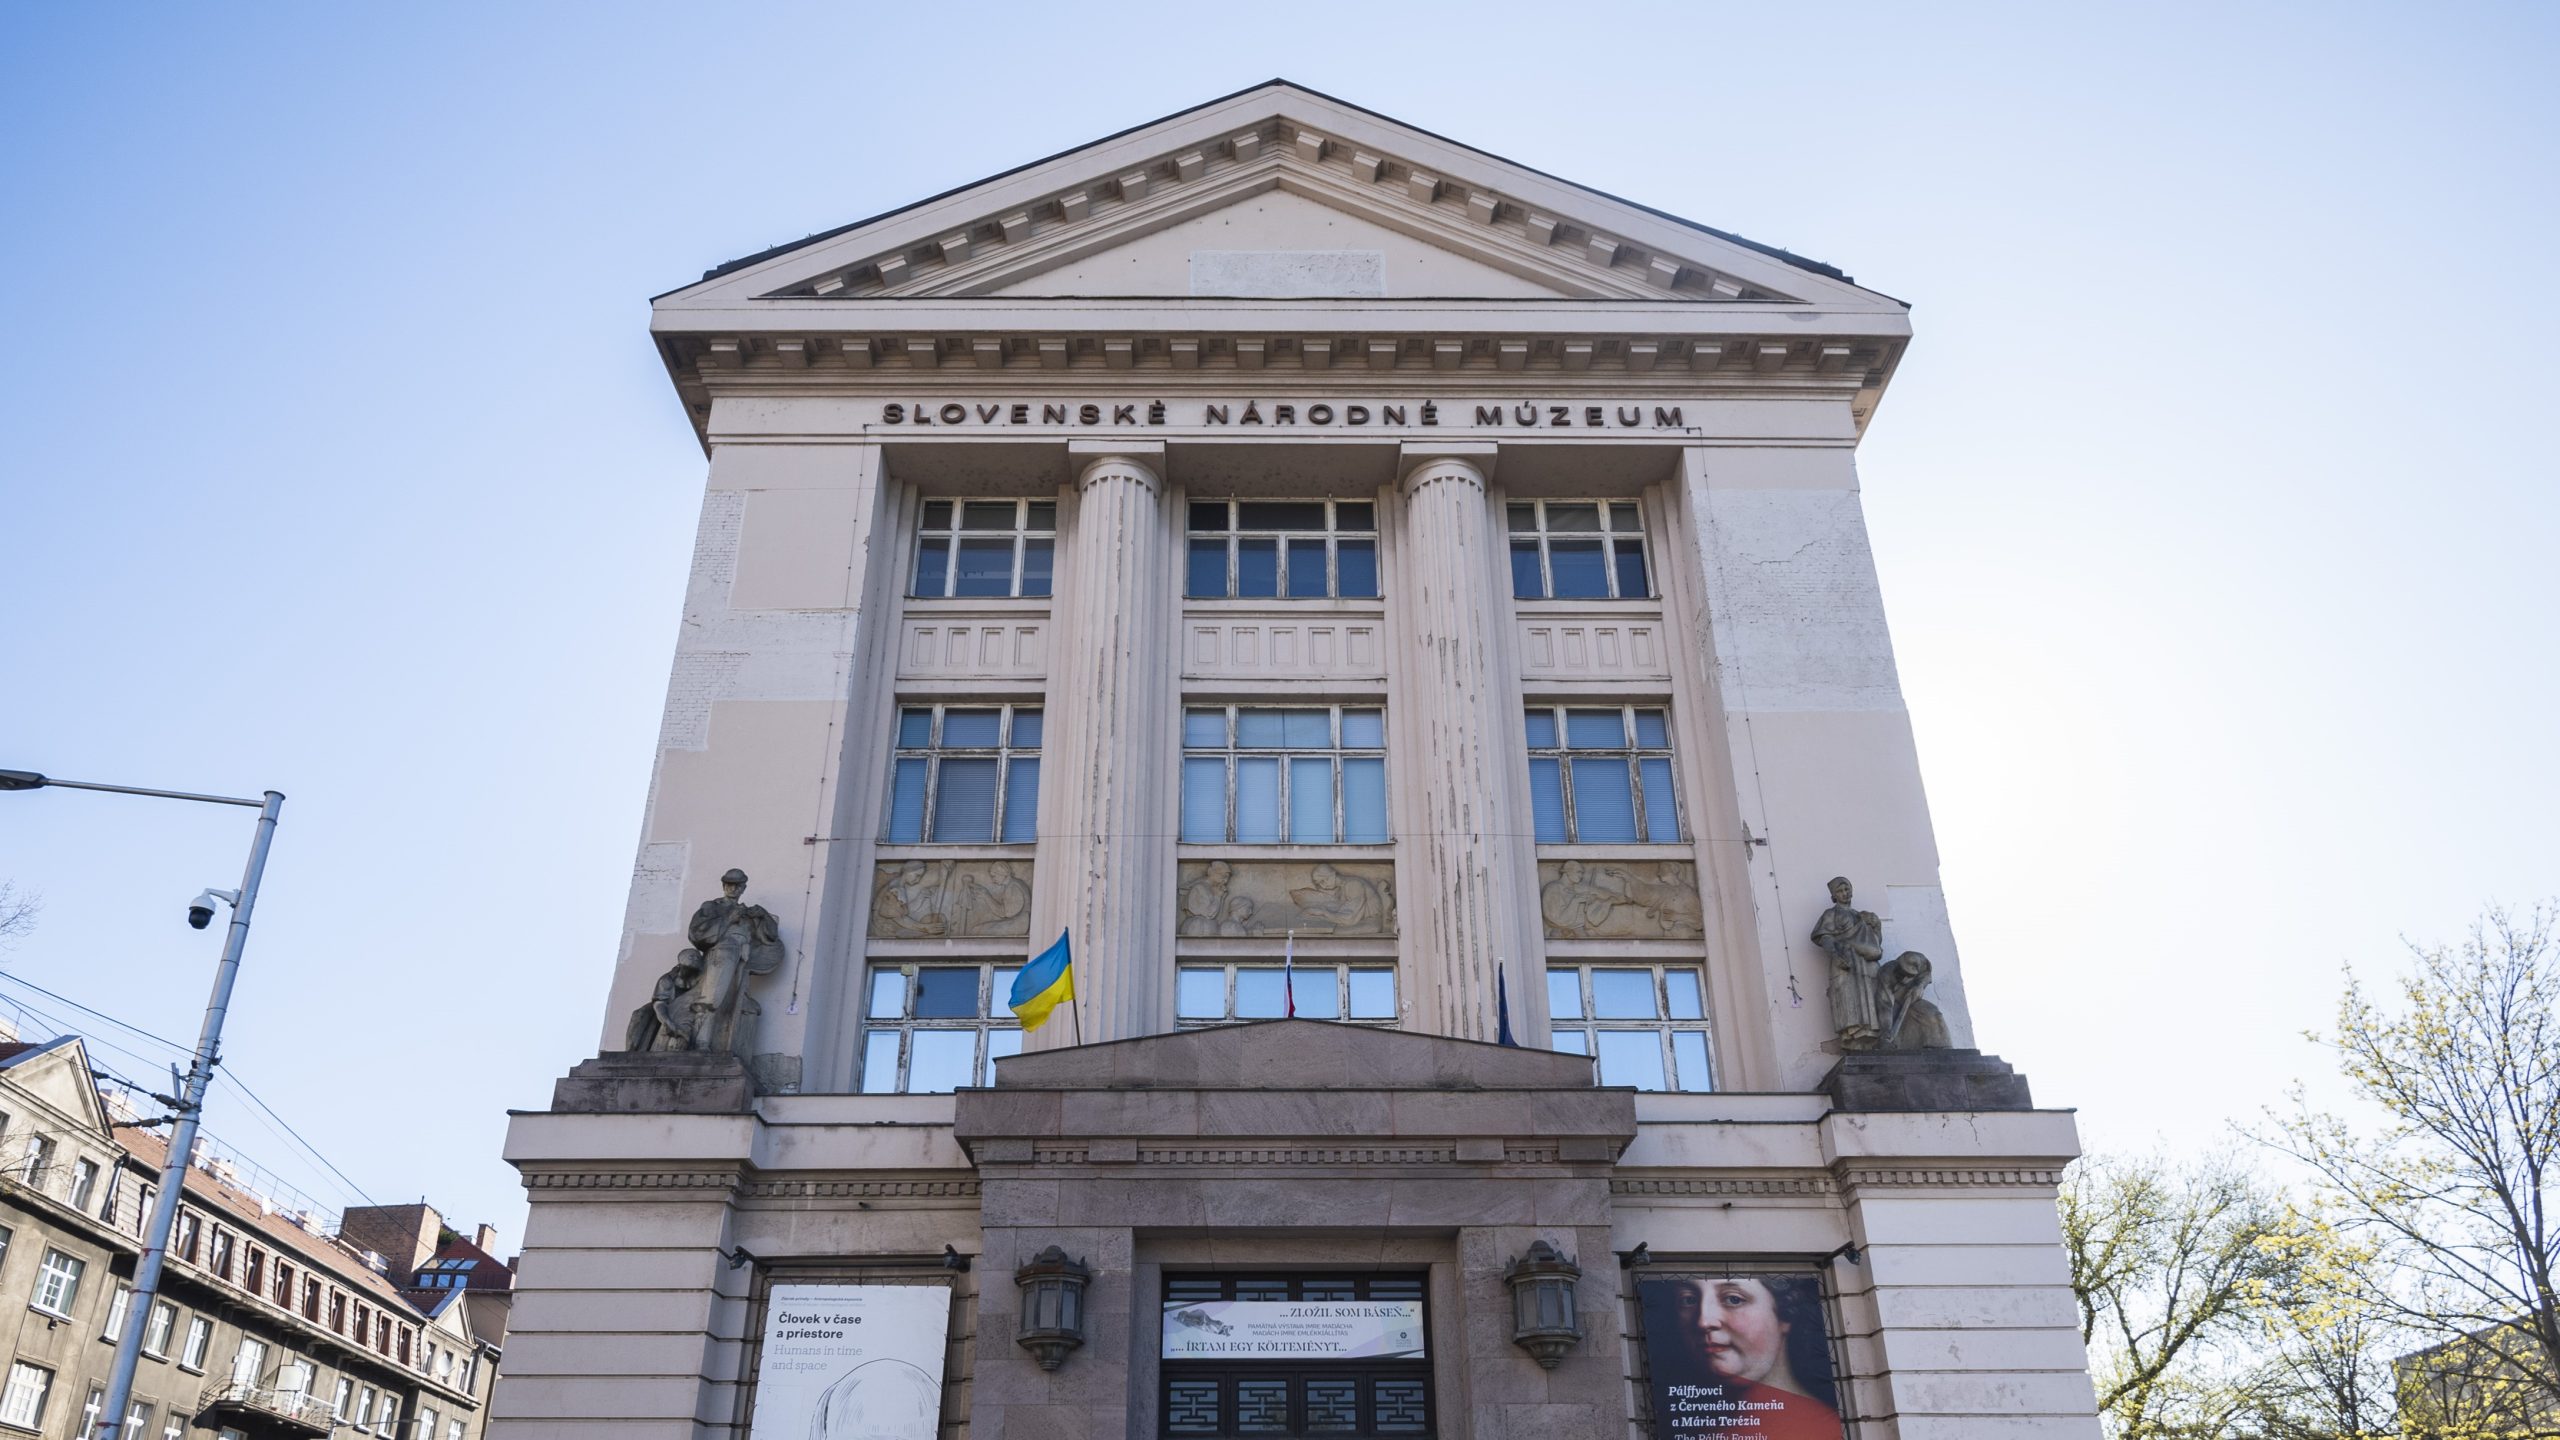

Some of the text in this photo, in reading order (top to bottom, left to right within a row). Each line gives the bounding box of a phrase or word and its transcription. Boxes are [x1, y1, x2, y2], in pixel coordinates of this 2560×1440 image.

[883, 400, 1683, 427] SLOVENSKÉ NÁRODNÉ MÚZEUM
[778, 1311, 862, 1324] Človek v čase
[1335, 1308, 1360, 1318] SOM
[776, 1328, 843, 1340] a priestore
[773, 1344, 863, 1356] Humans in time
[1230, 1342, 1253, 1352] EGY
[771, 1359, 828, 1374] and space
[1668, 1385, 1723, 1398] Pálffyovci
[1670, 1399, 1785, 1411] z Červeného Kameňa
[1672, 1415, 1761, 1427] a Mária Terézia
